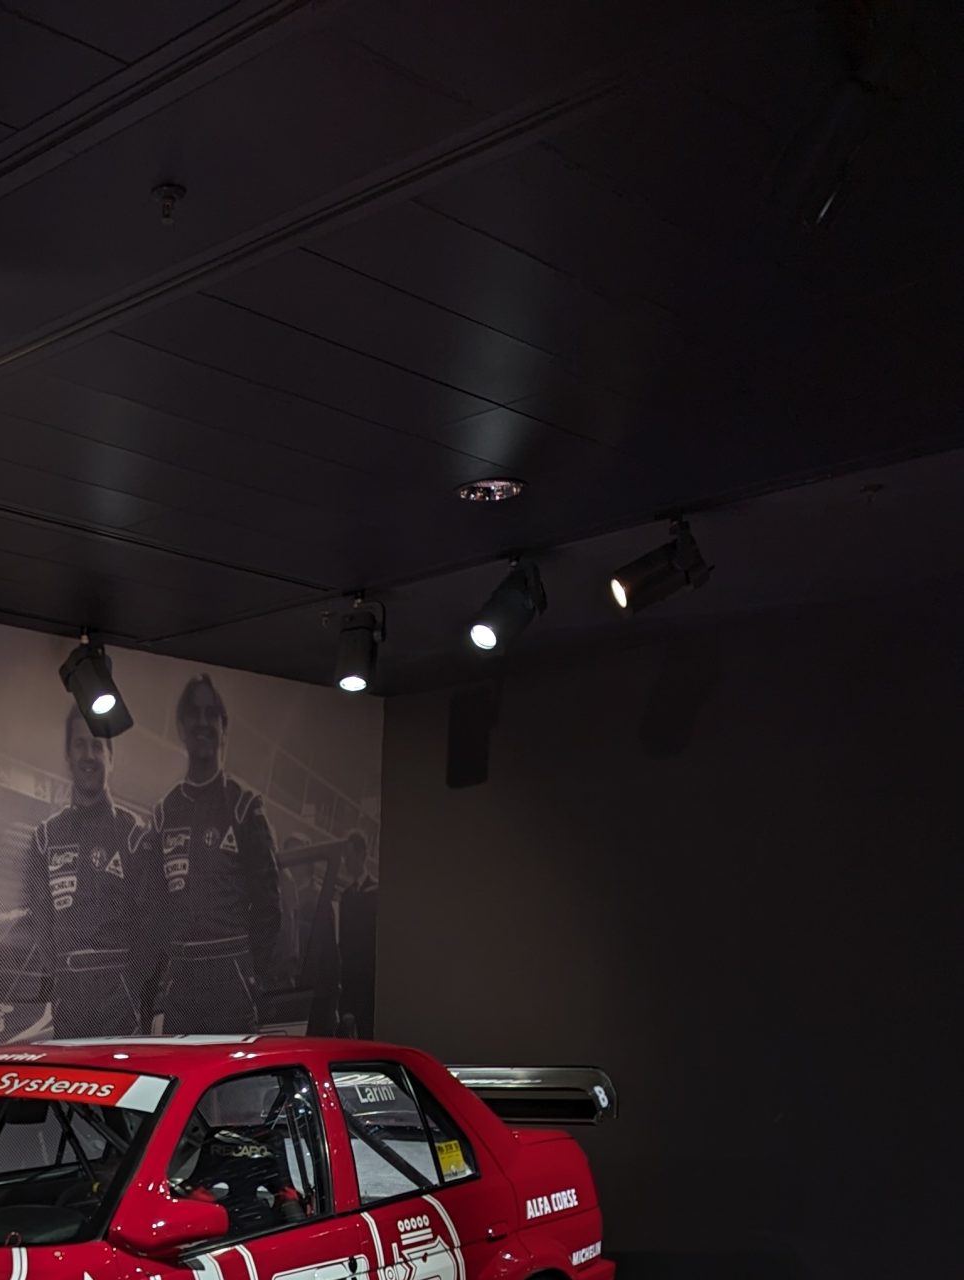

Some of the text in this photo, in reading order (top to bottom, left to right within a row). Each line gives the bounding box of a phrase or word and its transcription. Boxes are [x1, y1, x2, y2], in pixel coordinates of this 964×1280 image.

[355, 1084, 397, 1104] Larini
[526, 1188, 579, 1220] ALFA CORSE
